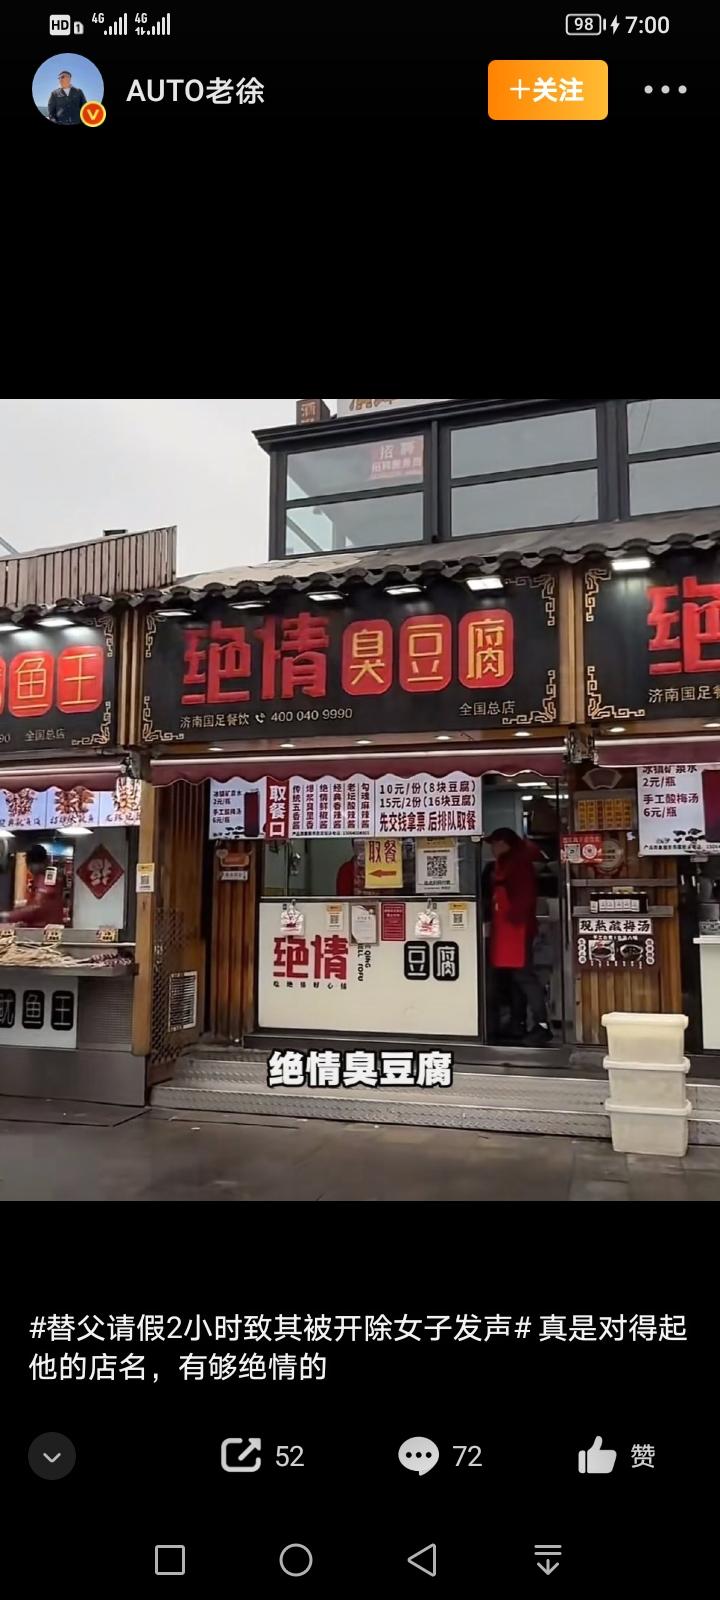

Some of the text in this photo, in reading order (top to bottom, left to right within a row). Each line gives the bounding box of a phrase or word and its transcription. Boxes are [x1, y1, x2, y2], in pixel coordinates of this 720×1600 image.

[0, 653, 98, 710] 鱼王
[180, 708, 353, 729] 济南国足餐饮 400 040 9990
[459, 700, 515, 717] 全国总店
[25, 728, 65, 742] 全国总店
[642, 776, 677, 788] 2元/瓶
[643, 793, 699, 805] 手工酸梅汤
[269, 785, 287, 837] 取餐口
[379, 810, 477, 833] 先交钱拿票 后排队取餐
[643, 806, 678, 818] 6元/瓶
[367, 839, 397, 864] 取餐
[407, 945, 456, 977] 豆腐
